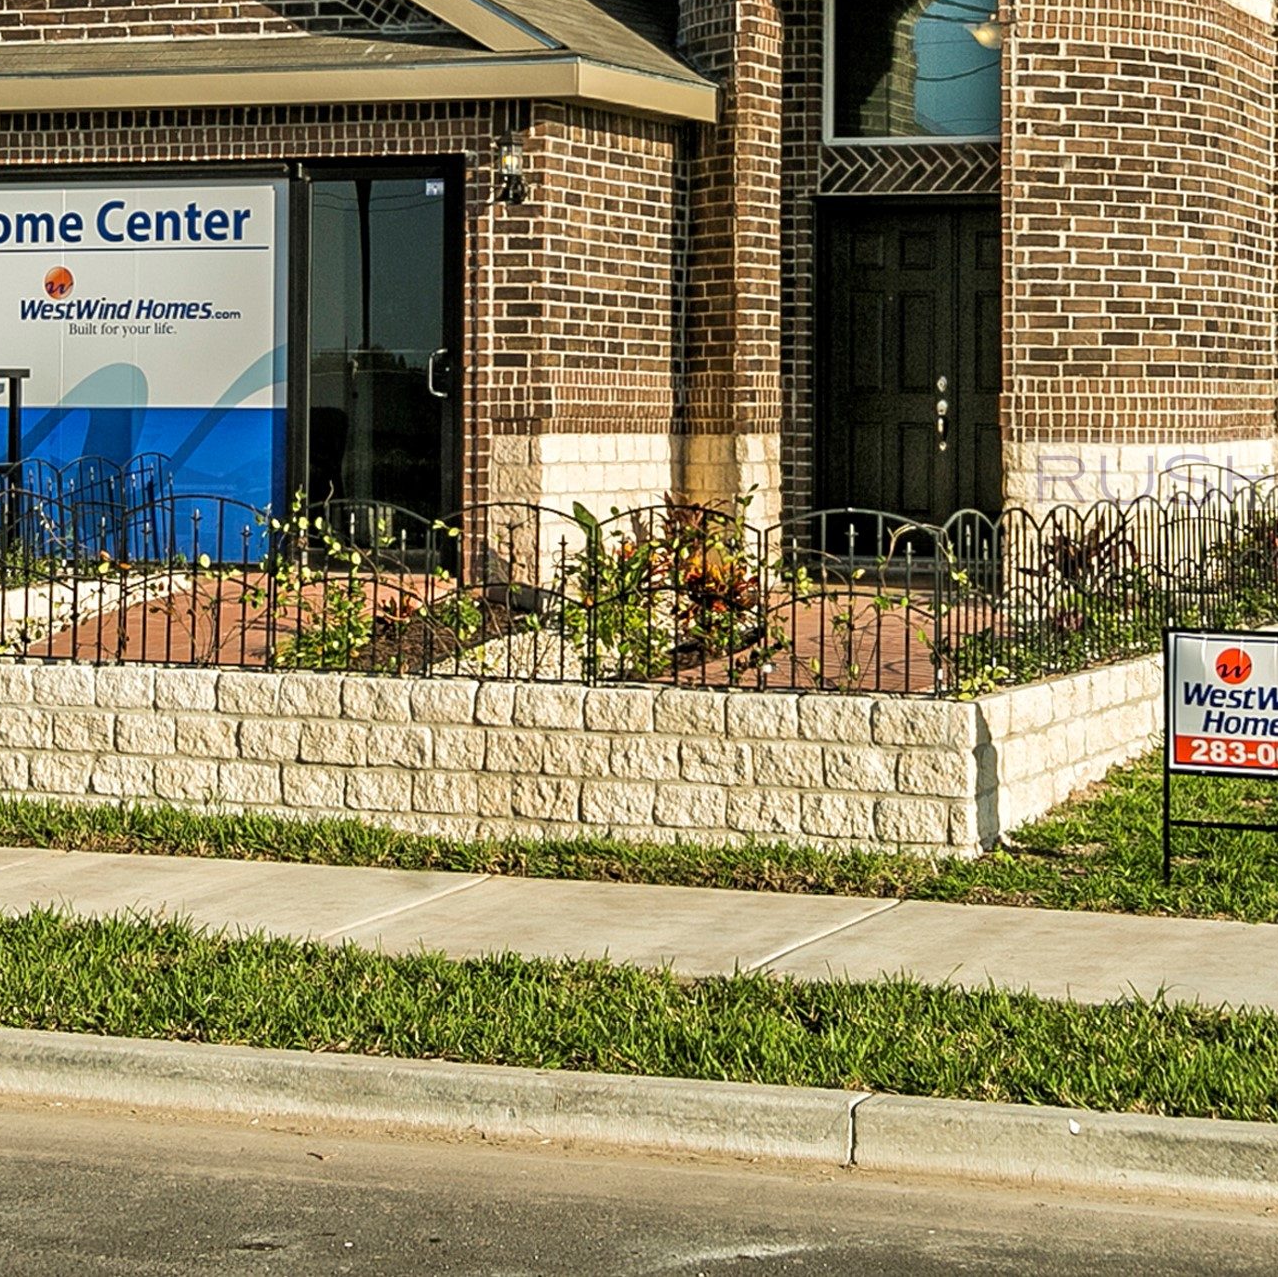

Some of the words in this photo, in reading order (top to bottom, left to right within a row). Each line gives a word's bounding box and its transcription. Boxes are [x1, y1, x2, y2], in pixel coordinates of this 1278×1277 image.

[96, 200, 251, 242] Center
[20, 297, 133, 321] WestWind
[135, 298, 242, 320] Homes.com
[68, 321, 97, 336] Built
[100, 321, 120, 335] for
[122, 323, 150, 339] your
[153, 321, 178, 335] life.
